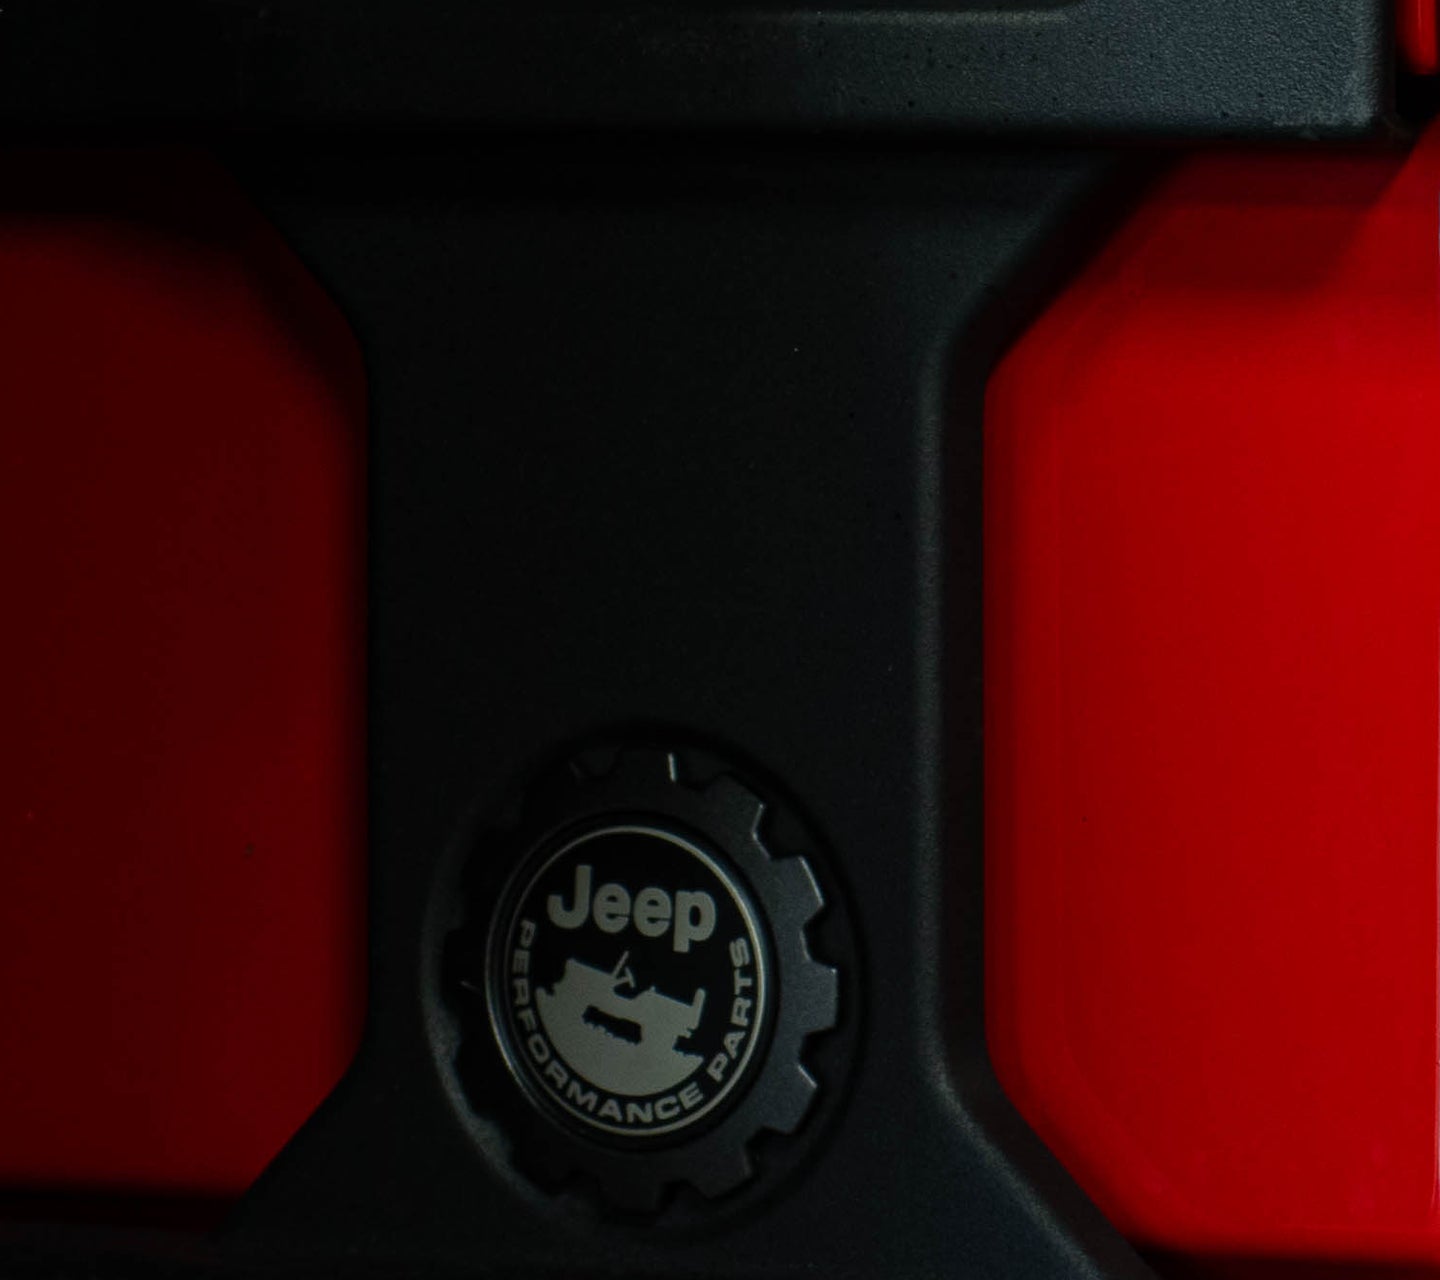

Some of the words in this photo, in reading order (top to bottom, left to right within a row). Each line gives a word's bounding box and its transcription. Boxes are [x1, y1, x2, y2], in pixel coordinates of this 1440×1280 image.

[547, 865, 716, 953] Jeep
[512, 920, 705, 1123] PERFORMANCE
[707, 937, 753, 1082] PARTS
